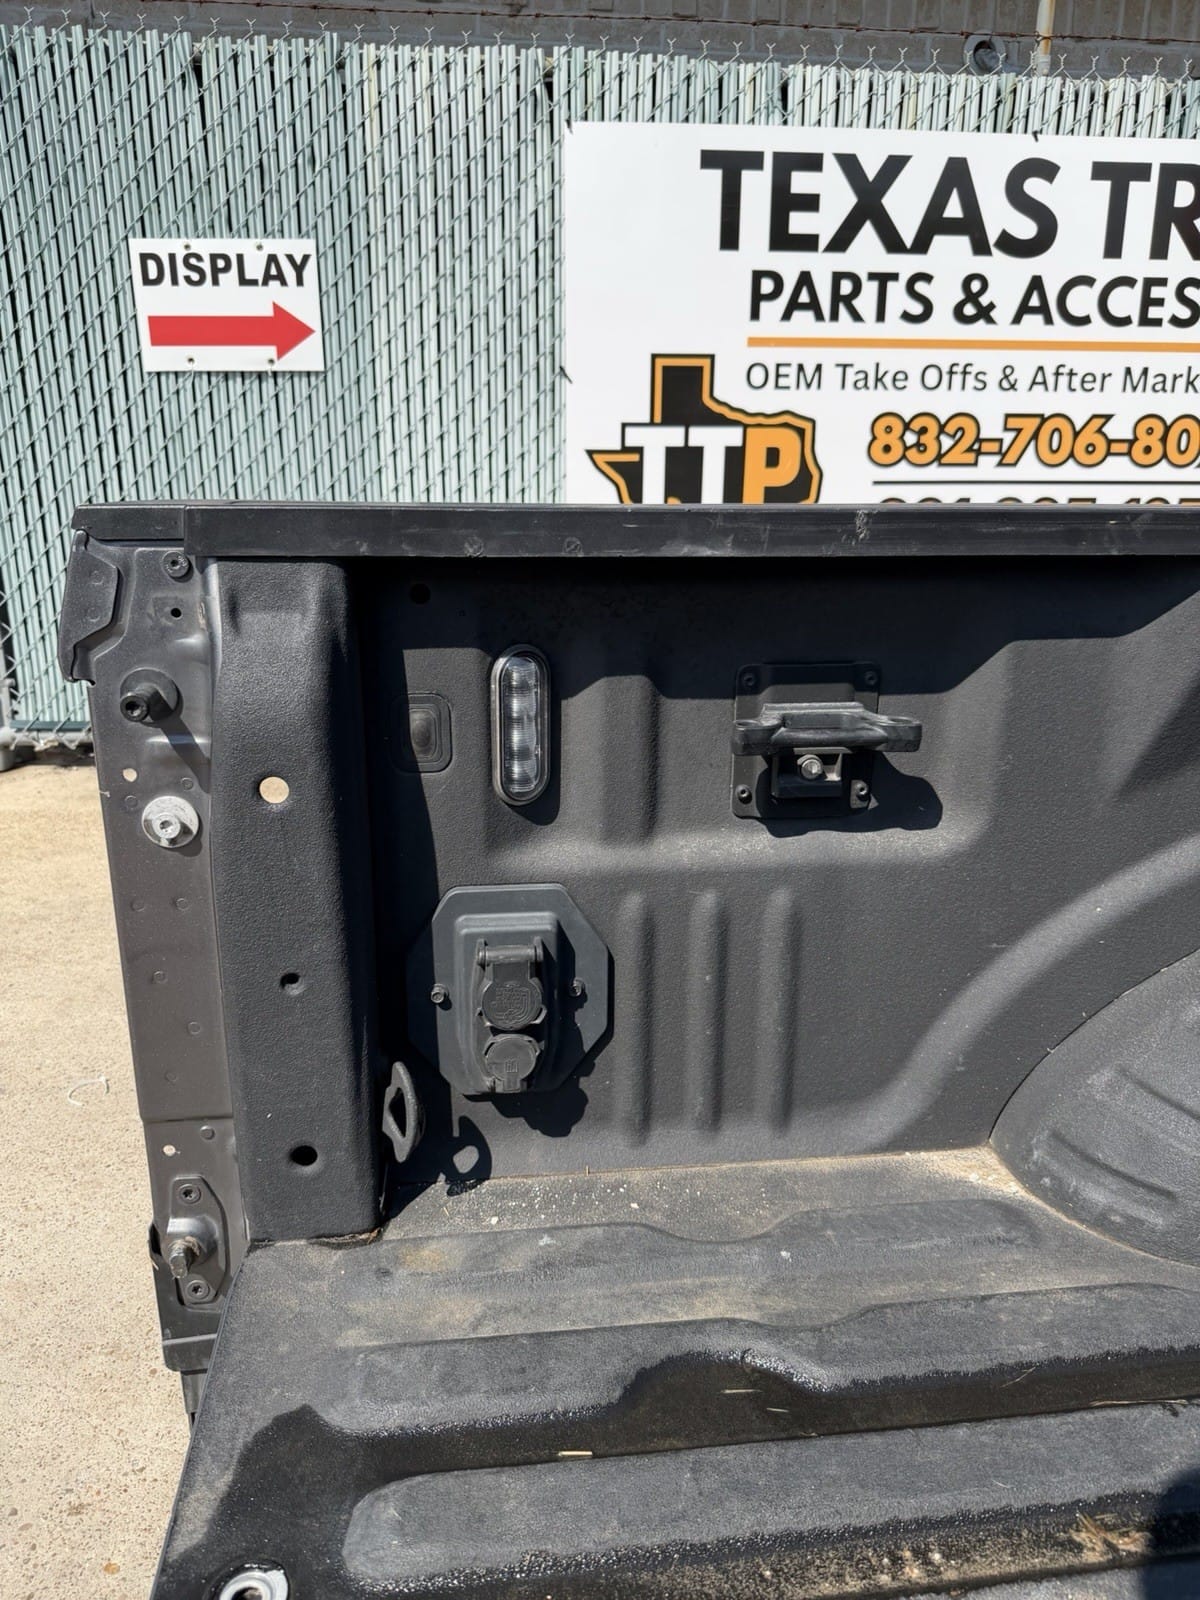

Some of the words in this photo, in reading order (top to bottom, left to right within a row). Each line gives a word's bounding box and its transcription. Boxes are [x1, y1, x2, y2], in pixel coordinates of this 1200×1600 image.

[700, 150, 1061, 259] TEXAS
[1090, 160, 1200, 261] TR
[139, 252, 312, 287] DISPLAY
[749, 270, 935, 325] PARTS
[953, 273, 998, 325] &
[1011, 275, 1200, 329] ACCES
[746, 362, 823, 390] OEM
[835, 362, 909, 391] Take
[921, 362, 988, 391] Offs
[998, 364, 1018, 392] &
[1028, 364, 1112, 392] After
[1122, 366, 1200, 394] Mark
[623, 424, 802, 504] TTP
[867, 412, 1200, 468] 832-706-80
